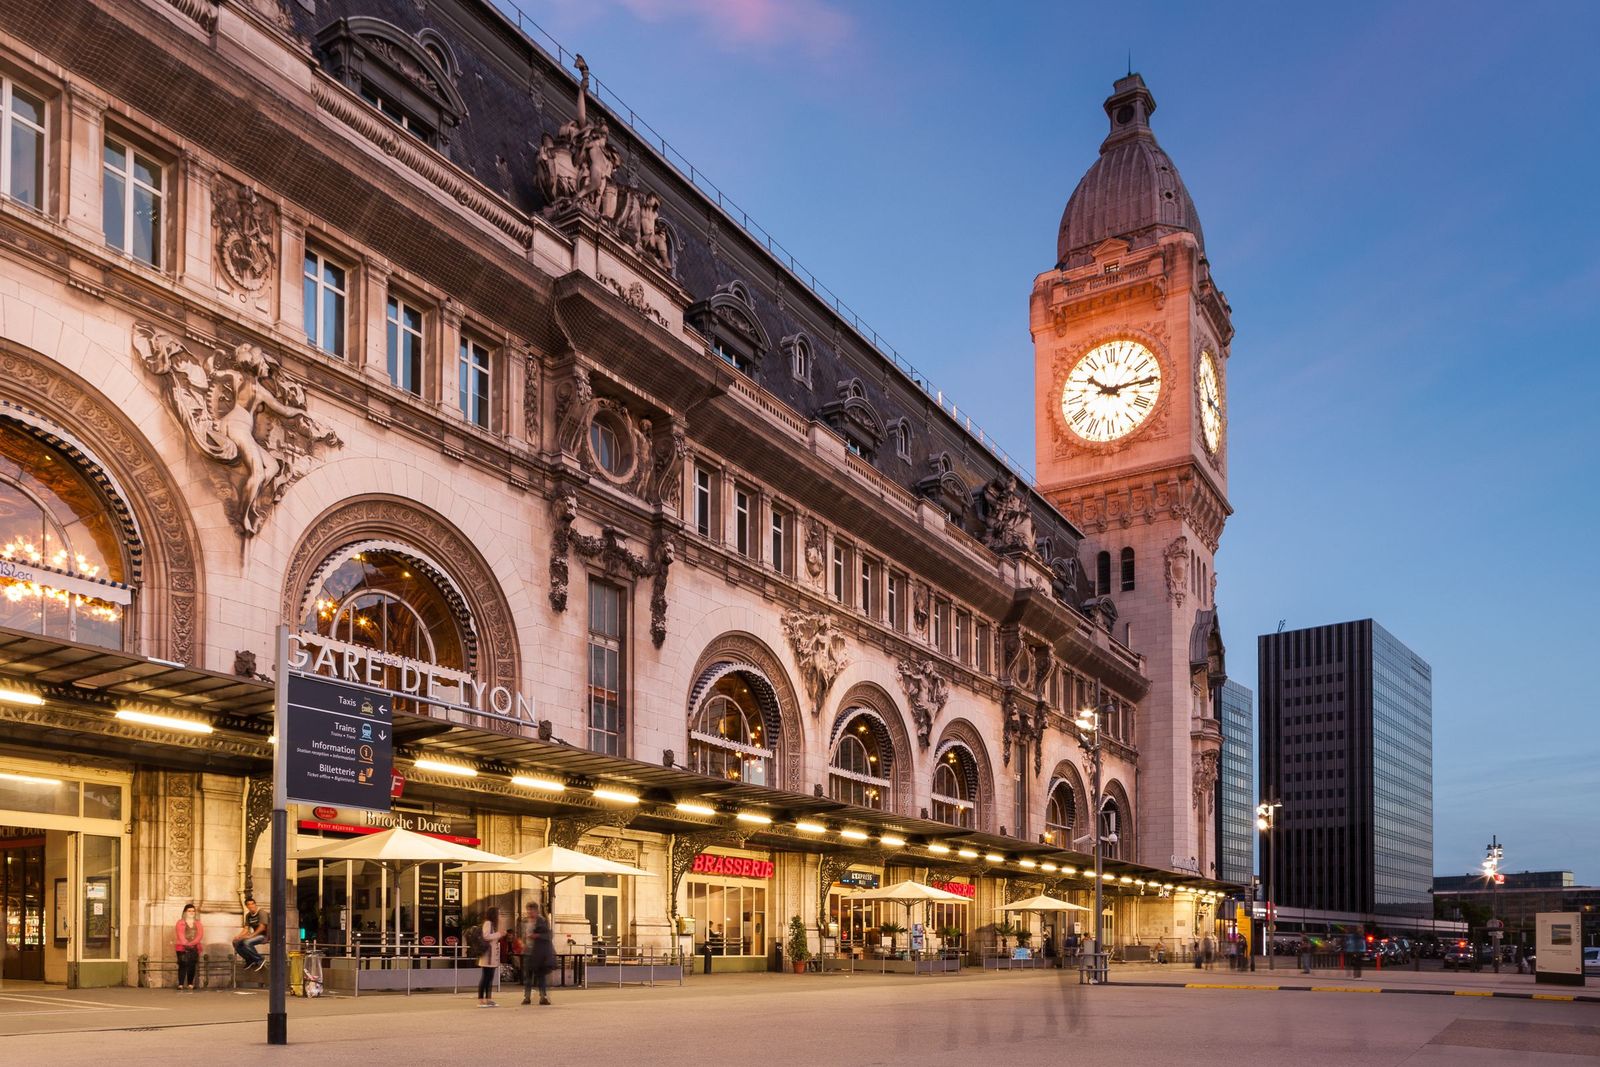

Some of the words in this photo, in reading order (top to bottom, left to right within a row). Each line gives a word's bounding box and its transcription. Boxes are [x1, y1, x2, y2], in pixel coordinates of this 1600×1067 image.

[288, 634, 383, 686] GARE
[402, 660, 442, 700] DE
[459, 677, 536, 722] LYON
[338, 696, 356, 707] Taxis
[334, 722, 356, 733] Trains
[312, 740, 356, 755] Information
[319, 763, 356, 777] Billetterie
[365, 810, 413, 830] Brioche
[418, 816, 451, 834] Dorée
[693, 854, 774, 878] BRASSERIE
